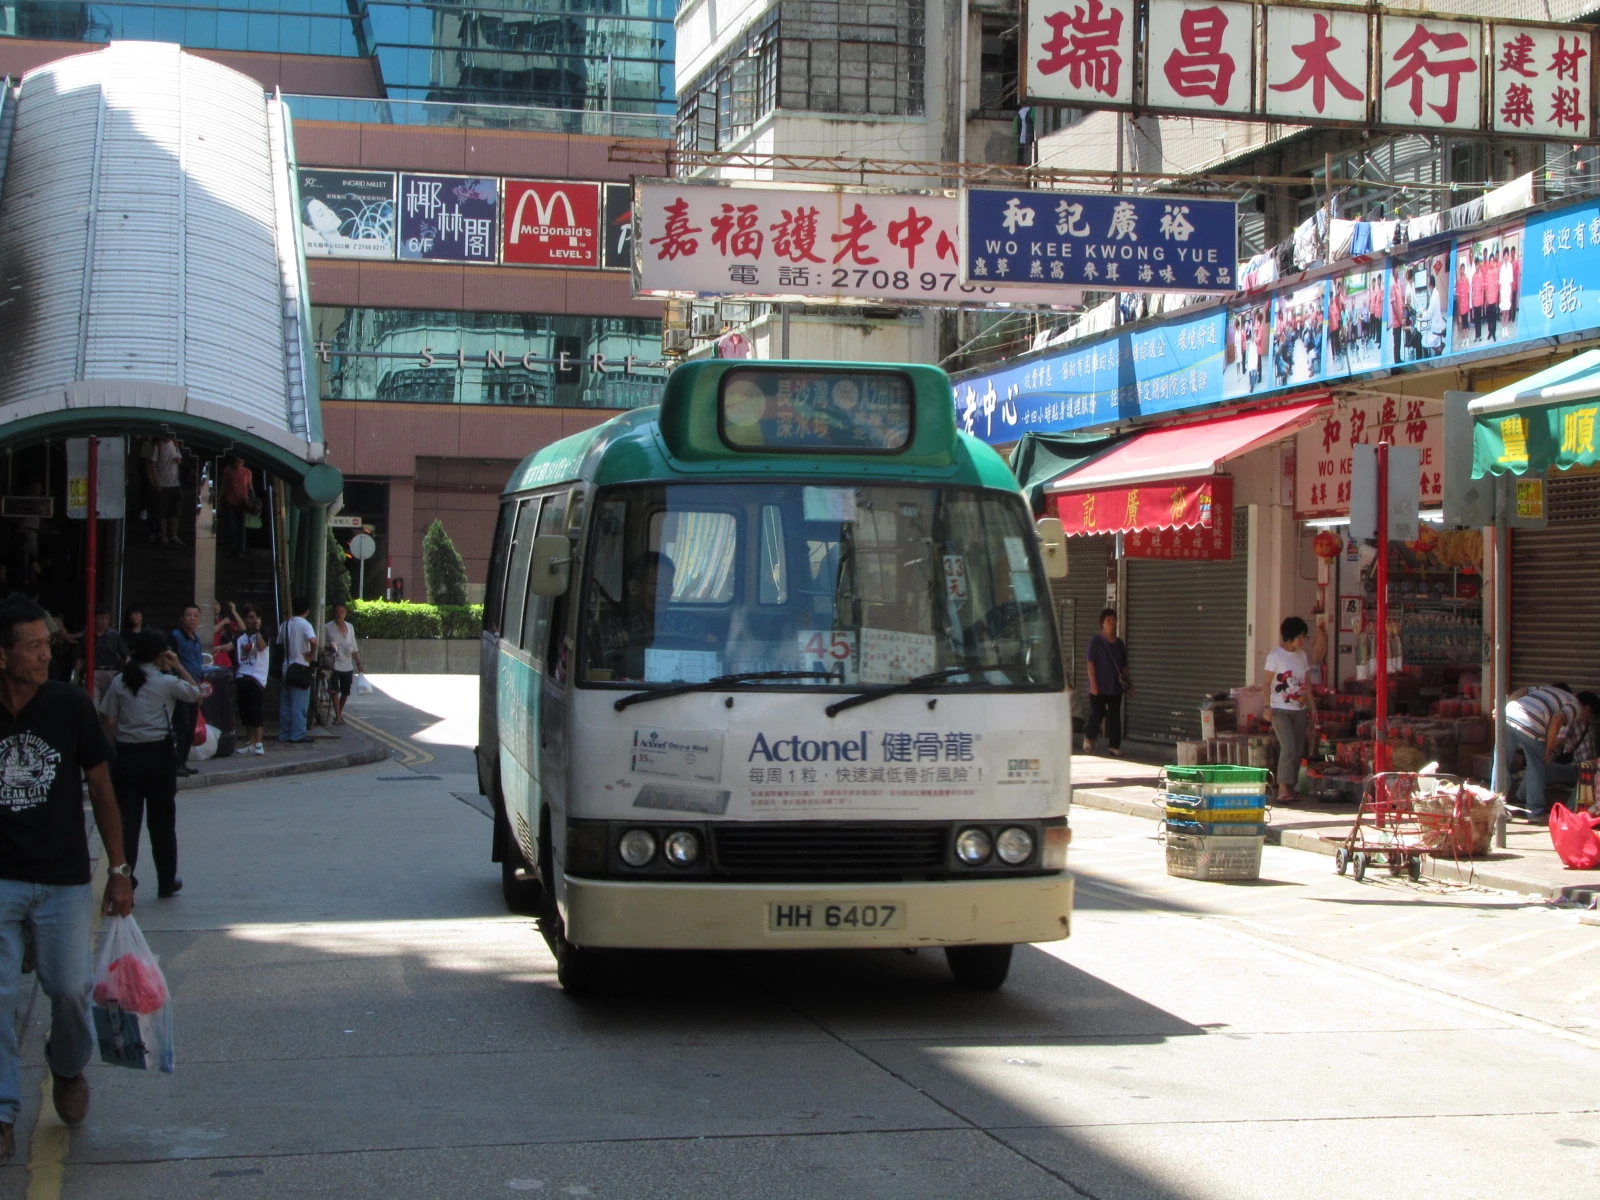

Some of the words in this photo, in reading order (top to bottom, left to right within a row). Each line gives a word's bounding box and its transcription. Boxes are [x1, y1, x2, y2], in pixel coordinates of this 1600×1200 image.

[1037, 0, 1478, 125] 瑞昌木行
[521, 224, 592, 238] McDonald's
[1002, 198, 1195, 241] 和記廣裕
[408, 238, 433, 253] 6/F
[549, 249, 583, 259] LEVEL
[584, 250, 592, 259] 3
[986, 240, 1018, 255] WO
[1031, 242, 1072, 258] KEE
[1085, 244, 1165, 261] KWONG
[1176, 248, 1218, 263] YUE
[831, 269, 910, 290] 2708
[1138, 264, 1176, 283] 海味
[1194, 266, 1231, 285] 食品
[419, 347, 640, 374] SINCERE
[952, 379, 1019, 437] 老中心
[1318, 461, 1334, 477] WO
[1340, 458, 1353, 475] KE
[804, 631, 851, 660] 45
[811, 661, 846, 684] M
[748, 730, 868, 762] Actonel
[881, 732, 974, 762] 健骨龍
[775, 906, 813, 927] HH
[824, 906, 897, 928] 6407
